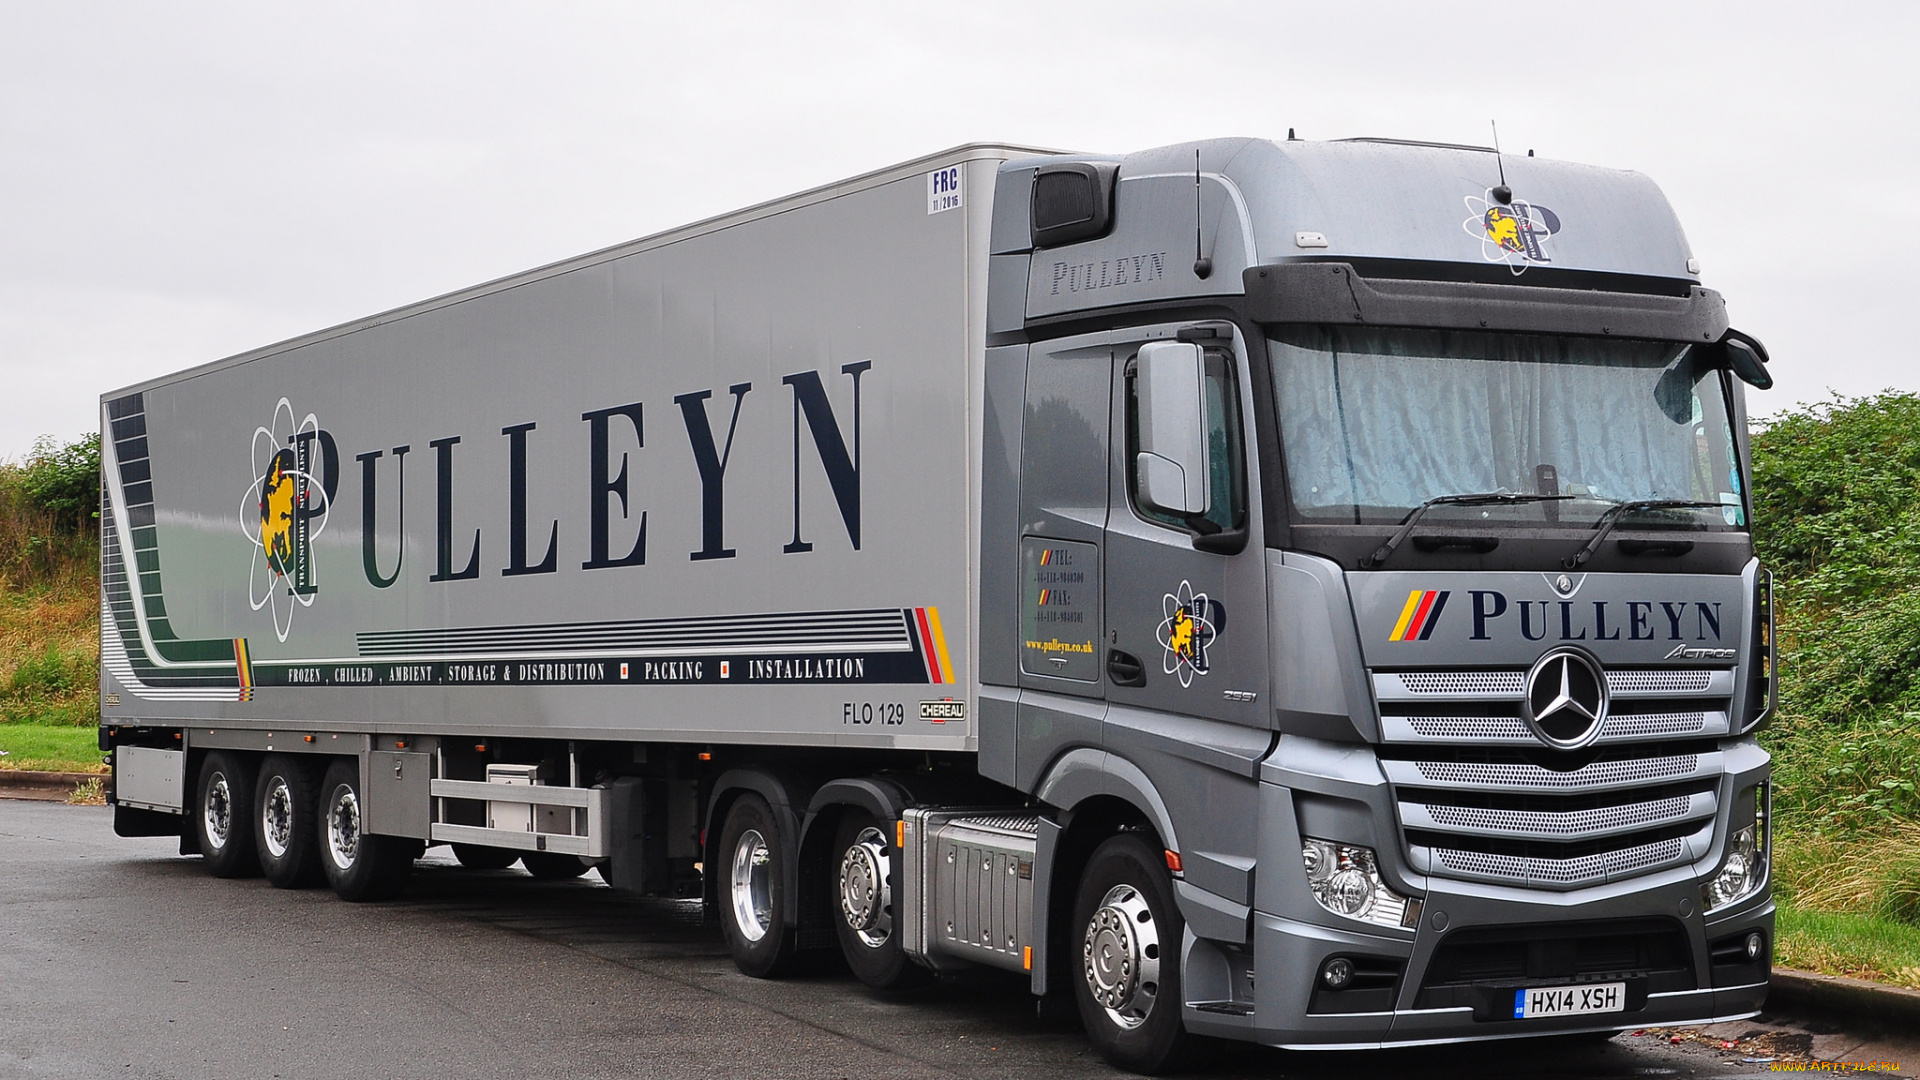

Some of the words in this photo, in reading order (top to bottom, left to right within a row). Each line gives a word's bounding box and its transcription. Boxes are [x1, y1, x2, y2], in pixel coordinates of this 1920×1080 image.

[933, 168, 957, 194] FRC
[1051, 252, 1166, 295] PULLEYN
[288, 359, 872, 596] PULLEYN
[1054, 549, 1072, 566] TEL:
[1053, 589, 1071, 606] FAX:
[1467, 590, 1722, 641] PULLEYN
[1026, 638, 1093, 654] www.pulleyn.co.uk
[288, 668, 321, 682] FROZEN
[334, 667, 373, 682] CHILLED
[388, 666, 432, 682] AMBIENT
[448, 665, 497, 682] STORAGE
[503, 666, 511, 681] &
[519, 662, 605, 681] DISTRIBUTION
[645, 661, 703, 680] PACKING
[748, 658, 865, 679] INSTALLATION
[843, 702, 873, 725] FLO
[879, 703, 904, 725] 129
[920, 704, 964, 717] CHEREAU
[1531, 990, 1574, 1014] HX14
[1580, 986, 1617, 1010] XSH
